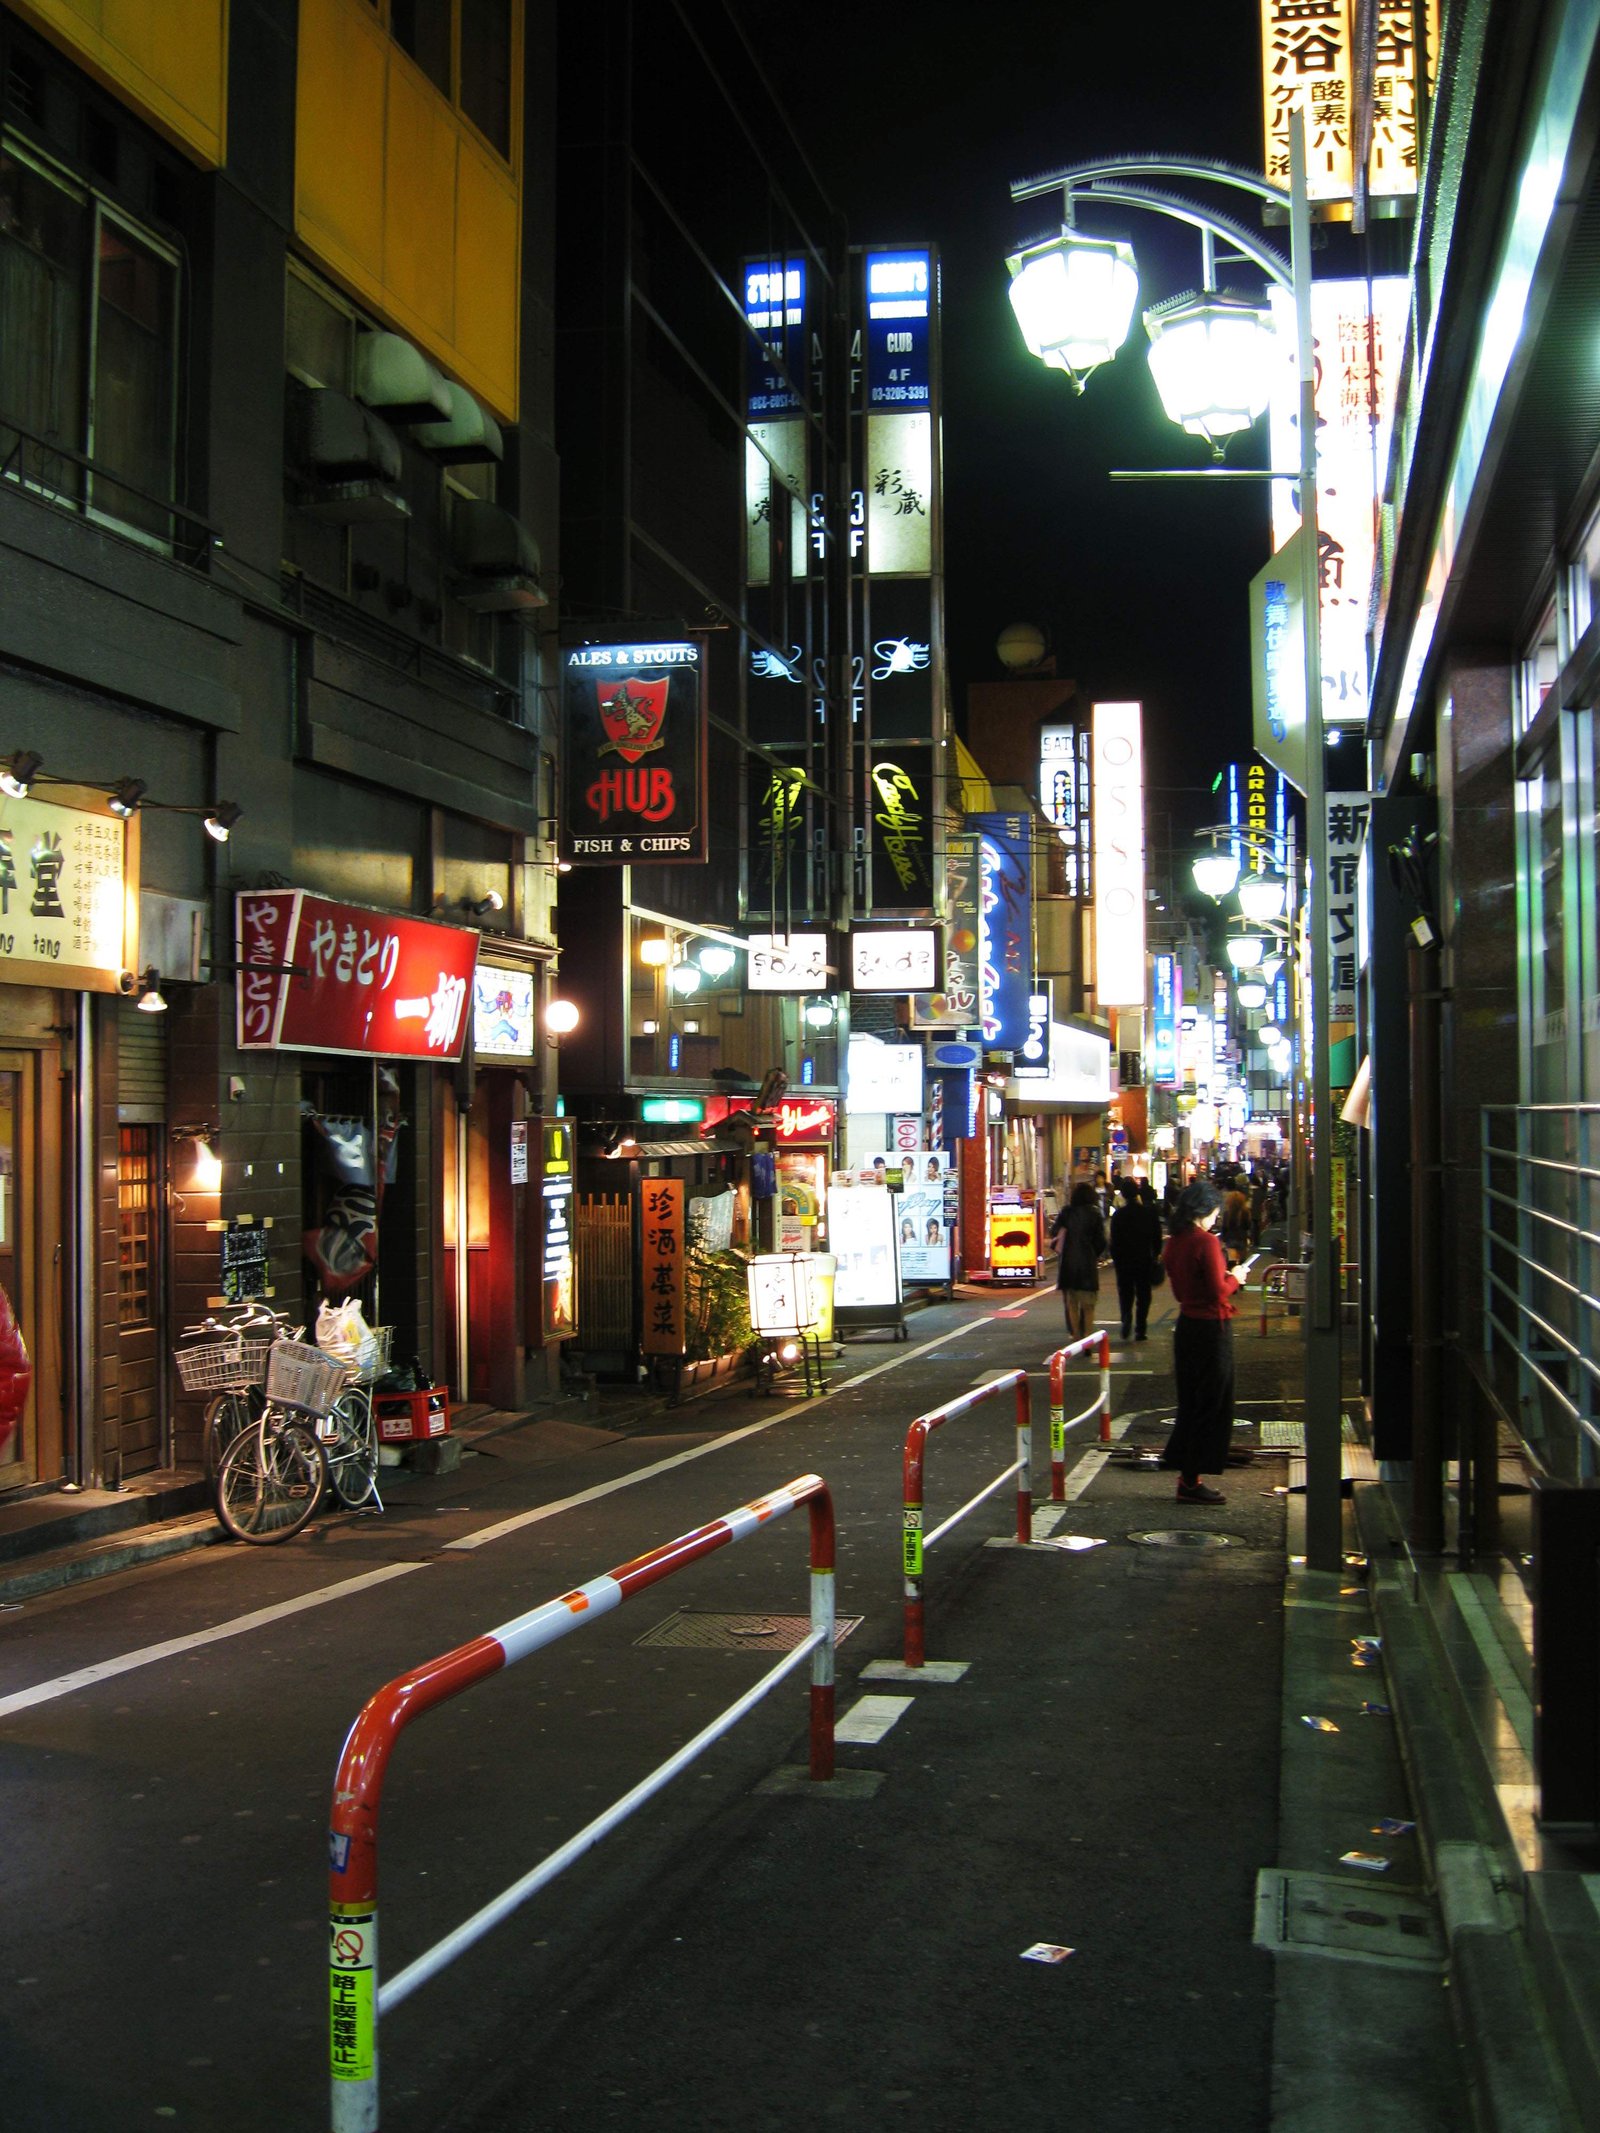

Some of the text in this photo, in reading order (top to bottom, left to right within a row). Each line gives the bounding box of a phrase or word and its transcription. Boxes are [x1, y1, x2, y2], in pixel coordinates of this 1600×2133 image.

[1271, 0, 1342, 75] 浴
[1311, 80, 1347, 172] 酸素バー
[850, 329, 862, 394] 4F
[886, 332, 913, 352] CLUB
[888, 368, 911, 381] 4F
[850, 491, 864, 558] 3F
[568, 648, 698, 666] ALES & STOUTS
[852, 656, 864, 723] 2F
[586, 768, 676, 823] HUB
[573, 838, 691, 853] FISH & CHIPS
[33, 933, 61, 960] tang
[245, 901, 279, 1037] やきとり
[310, 918, 400, 990] やきとり
